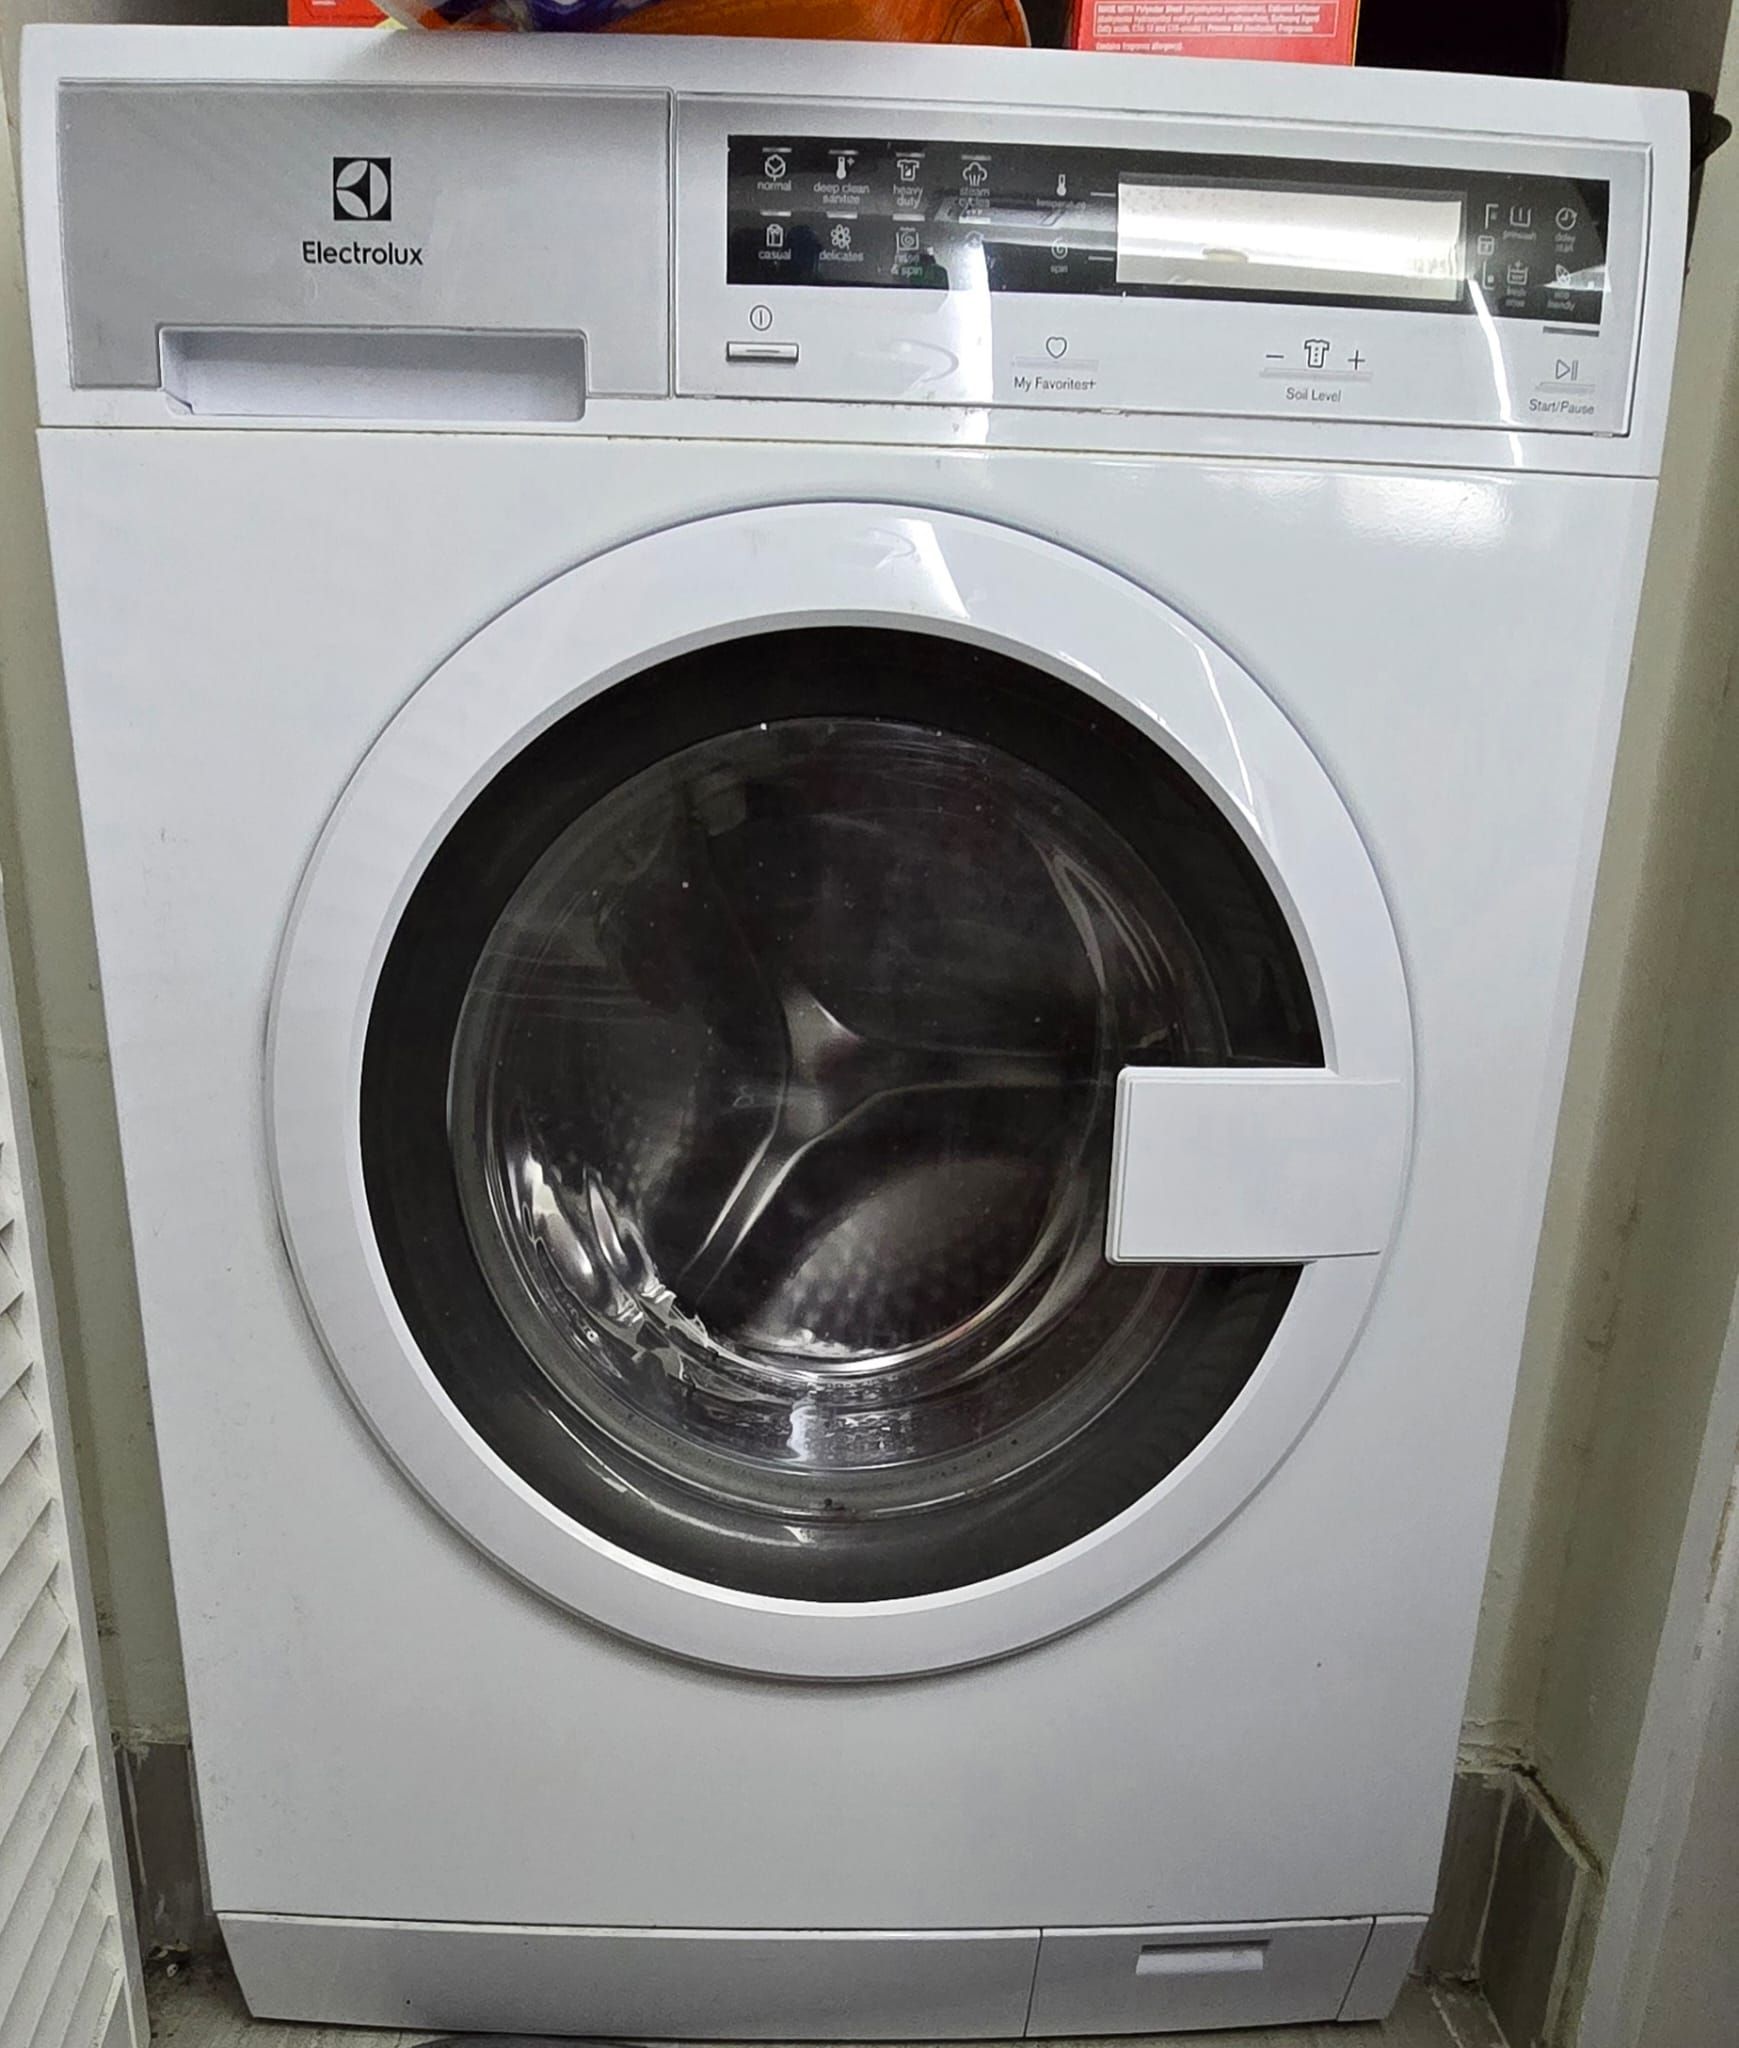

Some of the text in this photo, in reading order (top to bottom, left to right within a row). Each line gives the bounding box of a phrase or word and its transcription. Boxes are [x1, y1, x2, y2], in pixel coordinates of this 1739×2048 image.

[757, 180, 792, 192] normal
[813, 182, 870, 194] deep clean
[893, 184, 923, 196] heavy
[896, 194, 922, 209] duty
[302, 240, 424, 266] Electrolux
[758, 248, 792, 261] casual
[818, 249, 865, 262] delicates
[901, 265, 923, 278] spin
[1013, 376, 1033, 392] My
[1285, 386, 1342, 403] Soil Level
[1528, 398, 1596, 415] Start/Pause
